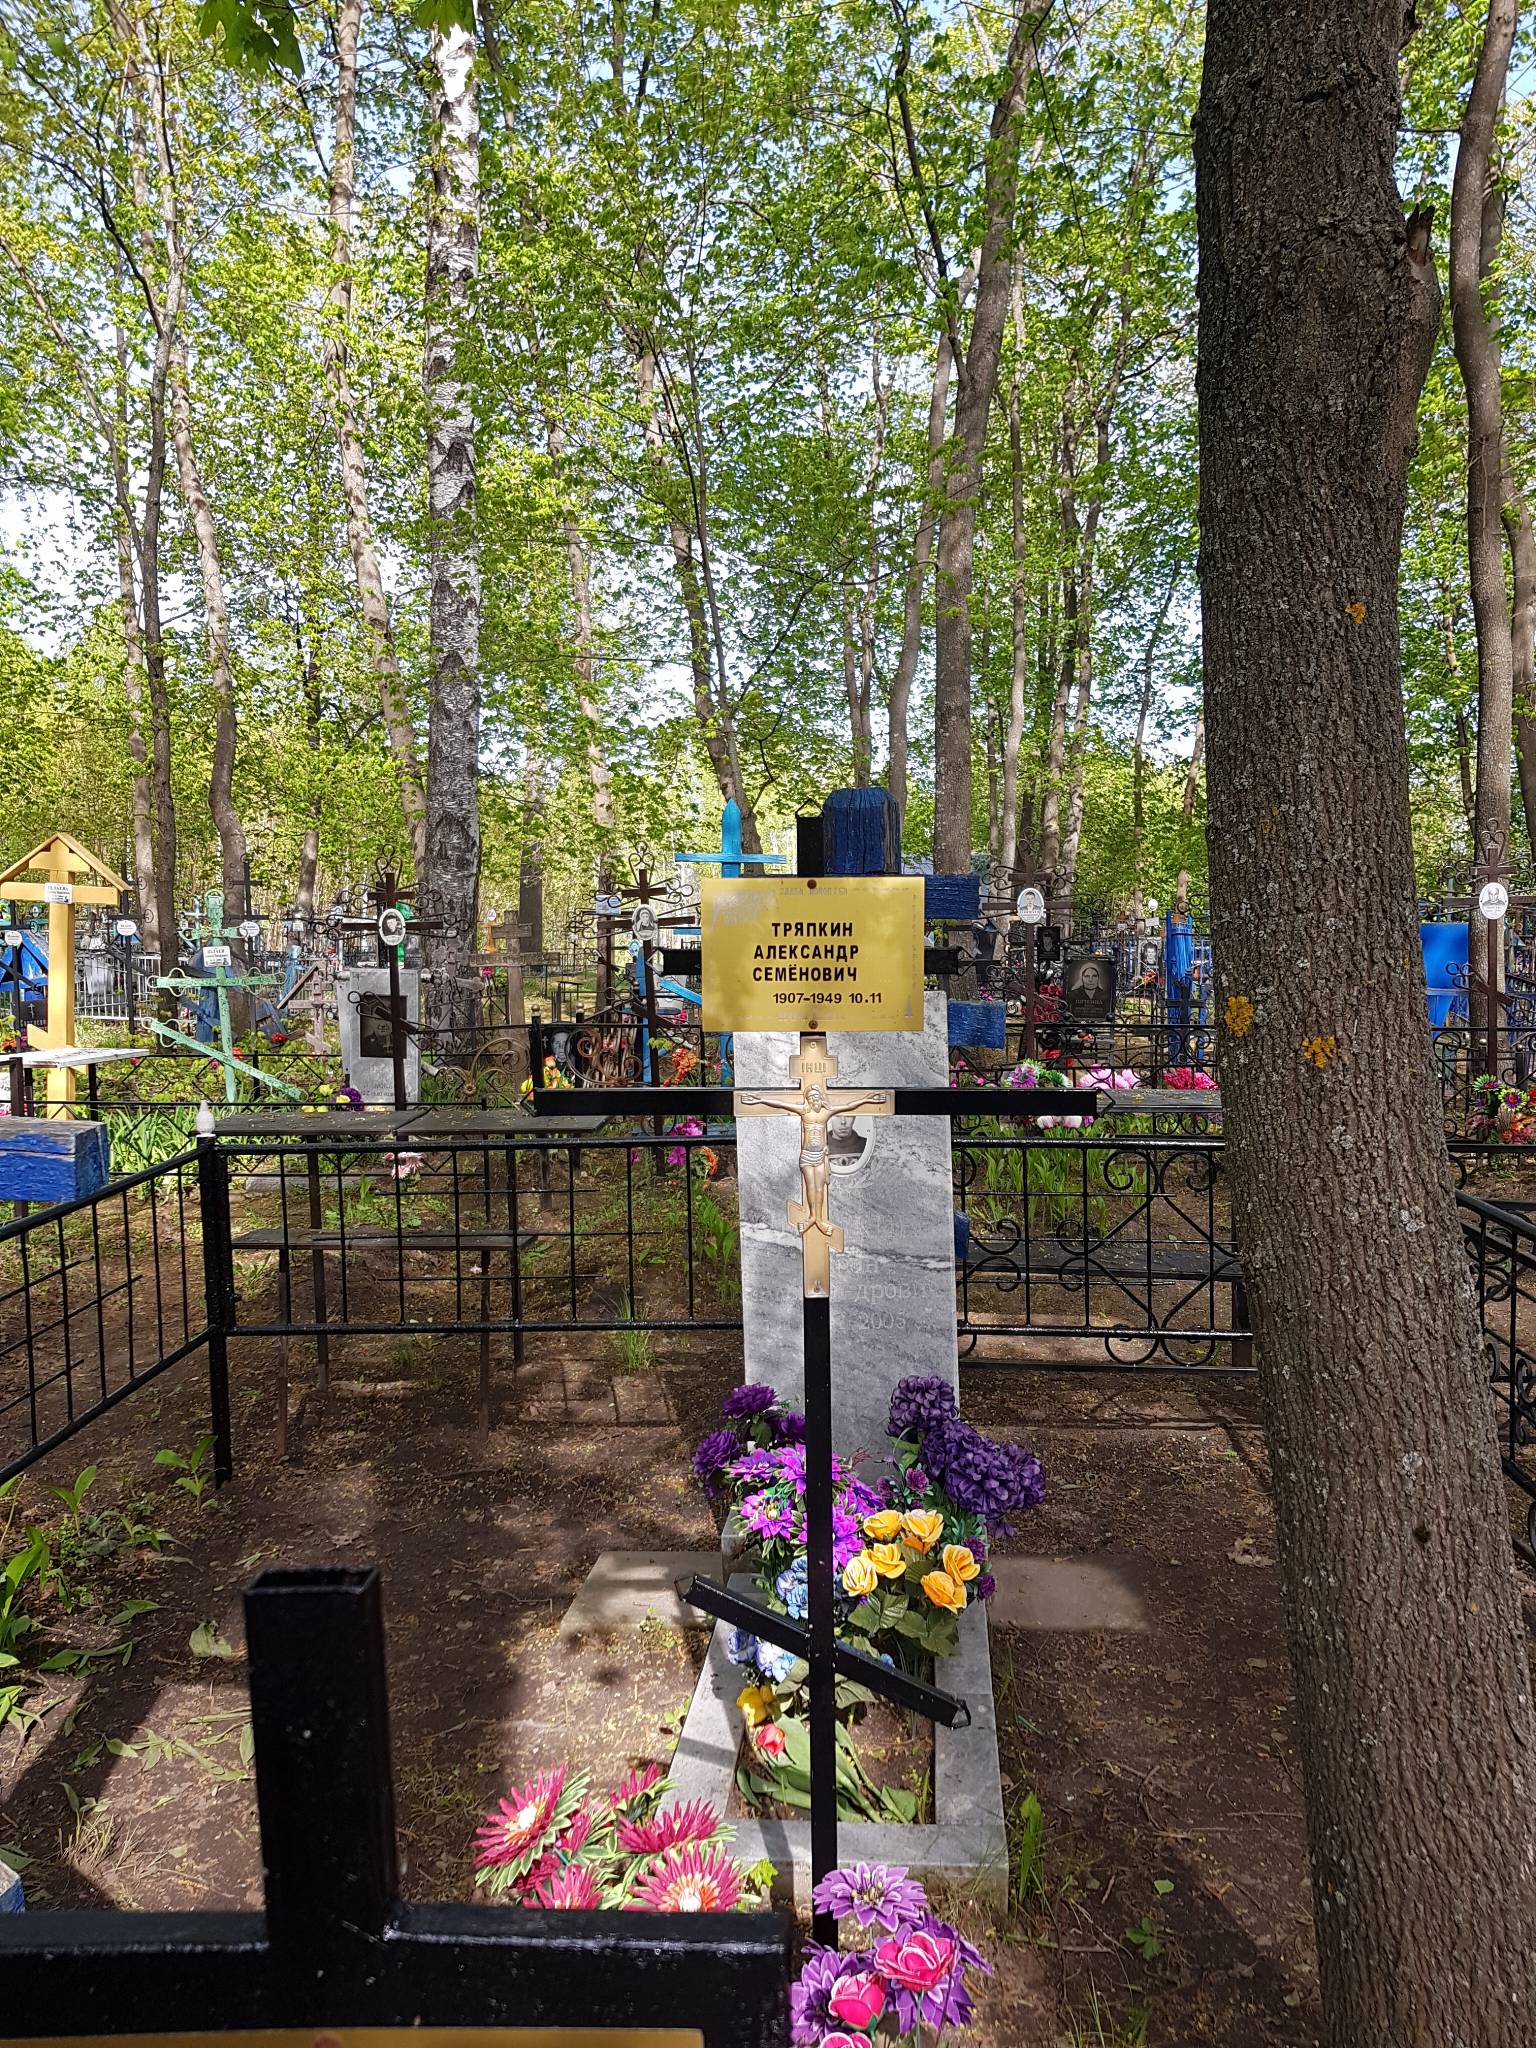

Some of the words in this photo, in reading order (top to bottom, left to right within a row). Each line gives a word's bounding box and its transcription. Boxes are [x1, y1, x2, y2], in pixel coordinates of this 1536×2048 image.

[772, 922, 853, 937] ТРЯПКИН
[753, 944, 859, 963] АЛЕКСАНДР
[752, 964, 857, 982] СЕМЁНОВИЧ
[773, 992, 842, 1004] 1907-1949
[848, 992, 882, 1004] 10.11
